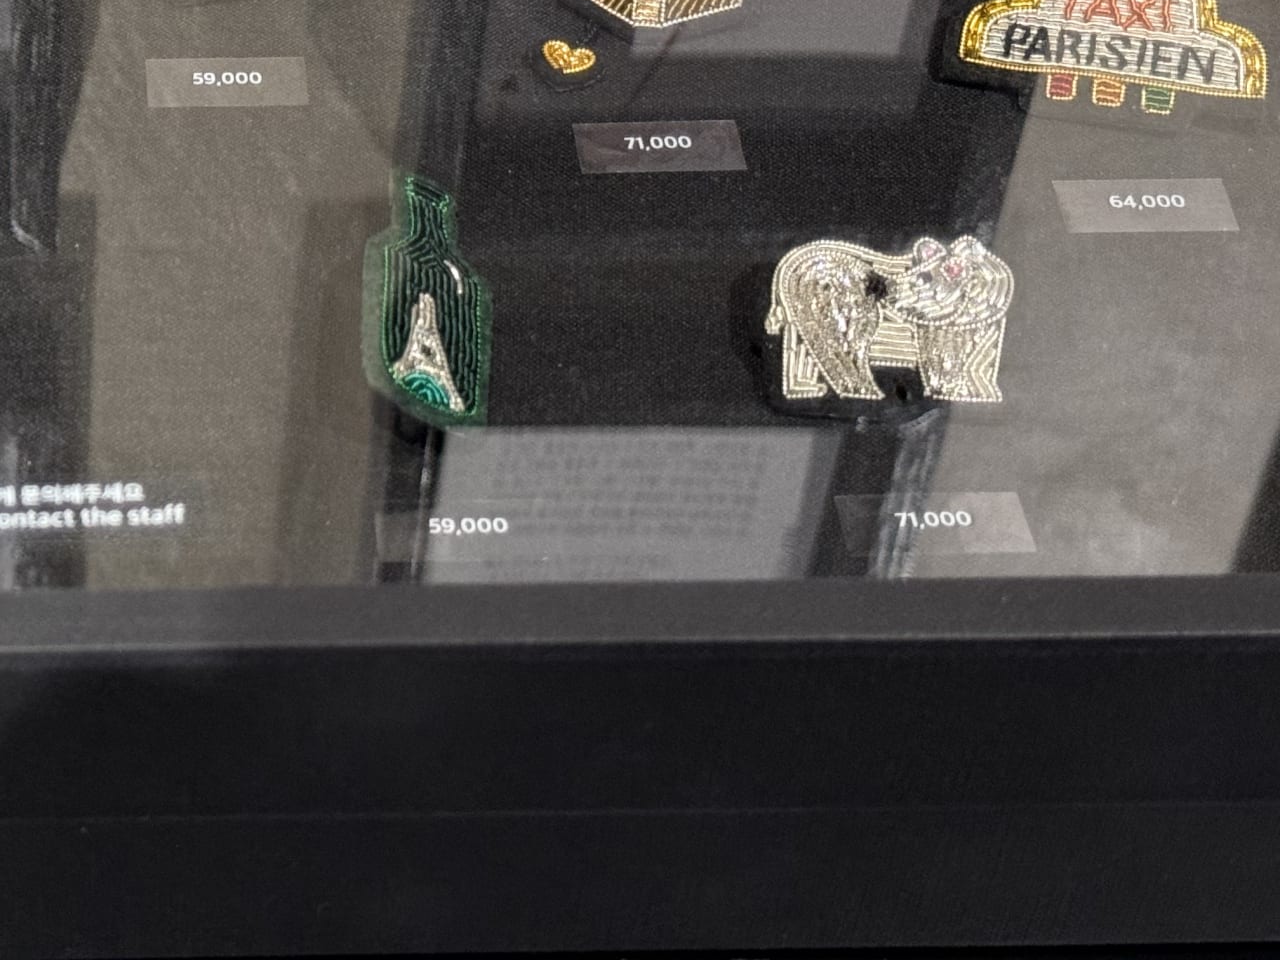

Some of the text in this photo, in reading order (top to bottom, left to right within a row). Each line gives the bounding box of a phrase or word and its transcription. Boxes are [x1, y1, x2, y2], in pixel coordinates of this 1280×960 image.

[1004, 22, 1216, 84] PARISIEN
[192, 70, 263, 87] 59,000
[623, 135, 692, 152] 71,000
[1109, 194, 1186, 211] 64,000
[80, 505, 123, 527] the
[126, 502, 186, 526] staff
[894, 510, 972, 530] 71,000
[429, 516, 509, 537] 59,000
